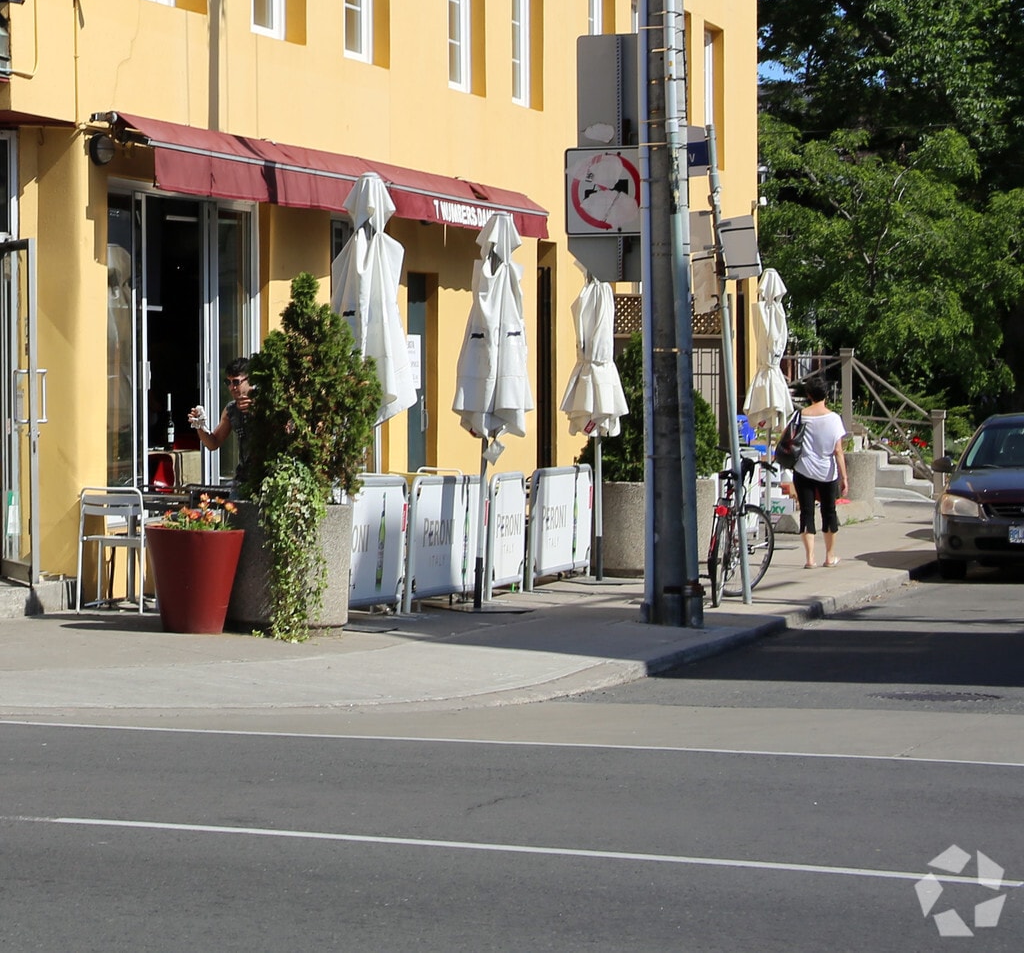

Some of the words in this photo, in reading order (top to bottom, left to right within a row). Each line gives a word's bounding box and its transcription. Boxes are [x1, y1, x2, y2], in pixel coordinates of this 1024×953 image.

[440, 200, 478, 226] NUMBERS
[496, 513, 523, 538] PERONI
[541, 504, 567, 532] PERONI
[351, 523, 370, 553] ONI
[422, 517, 456, 548] PERONI
